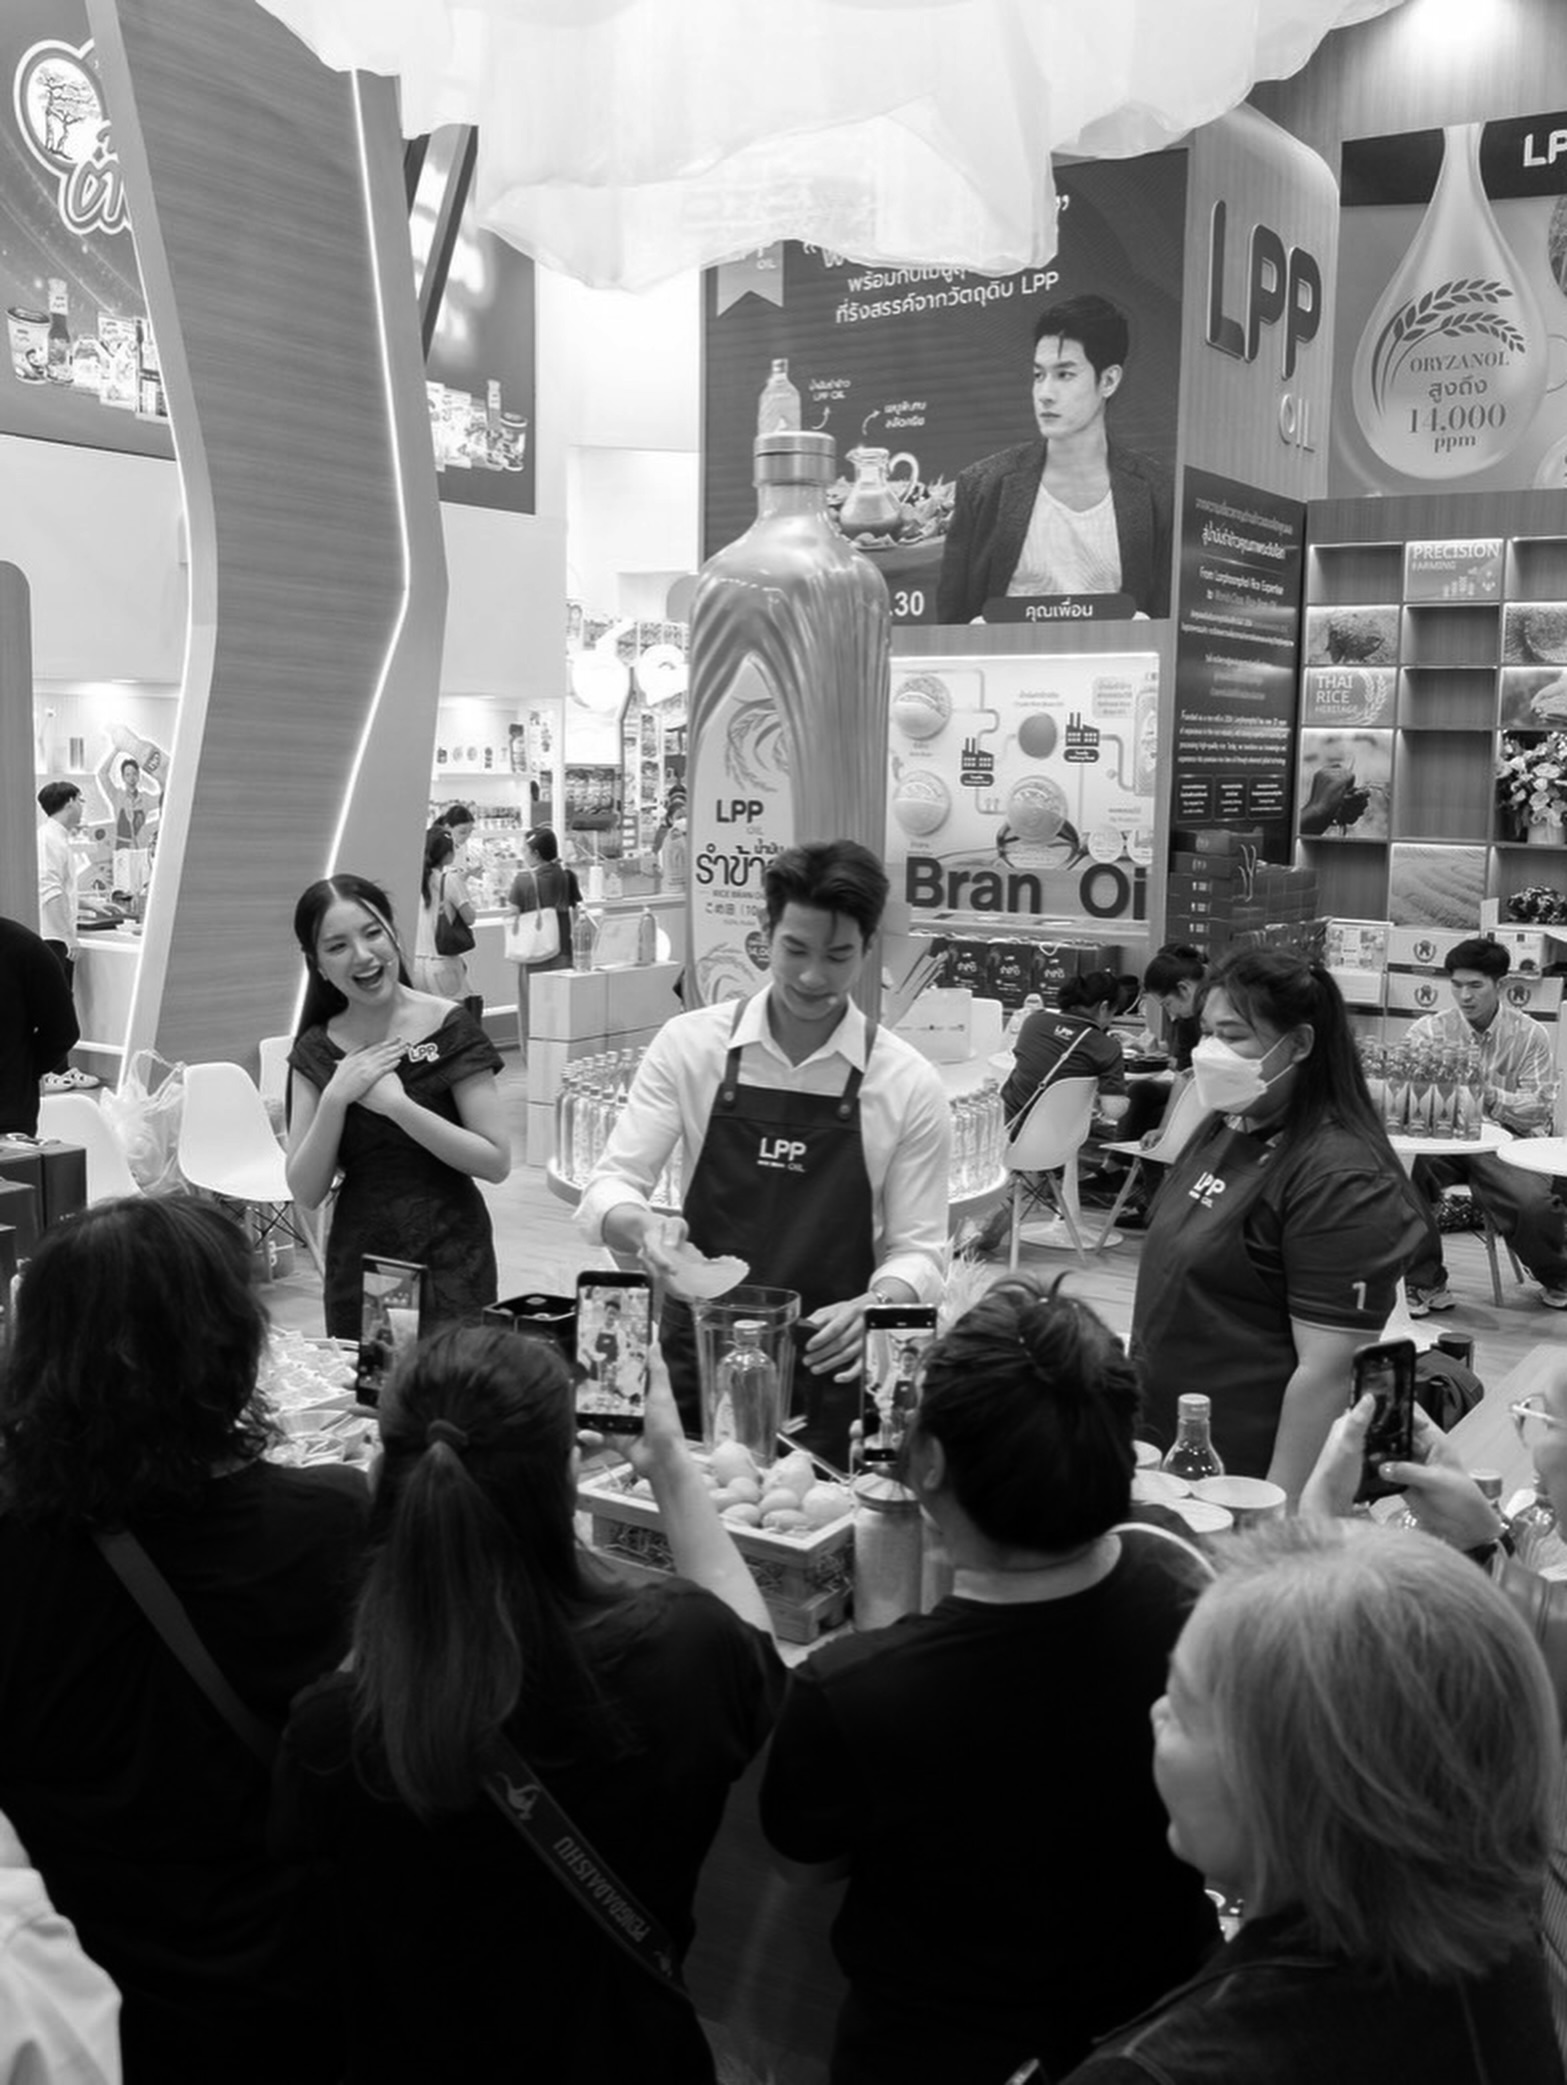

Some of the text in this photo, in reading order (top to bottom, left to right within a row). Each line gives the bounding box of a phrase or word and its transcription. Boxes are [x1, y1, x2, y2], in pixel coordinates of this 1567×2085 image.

[836, 272, 1060, 323] ที่รังสรรค์จากวัตถุดิบ LPP
[1206, 200, 1322, 381] LPP
[1409, 352, 1509, 373] ORYZANOL
[1428, 375, 1488, 403] สูงถึง
[1278, 394, 1315, 453] OIL
[1434, 435, 1477, 453] ppm
[1412, 543, 1500, 559] PRECISION
[1411, 560, 1457, 572] FARMING
[1025, 597, 1093, 622] คุณเพื่อน
[1316, 675, 1353, 689] THAI
[1315, 690, 1350, 704] RICE
[716, 799, 764, 823] LPP
[696, 843, 775, 886] รำข้า
[905, 856, 1148, 921] Bran Oi
[759, 1137, 807, 1161] LPP
